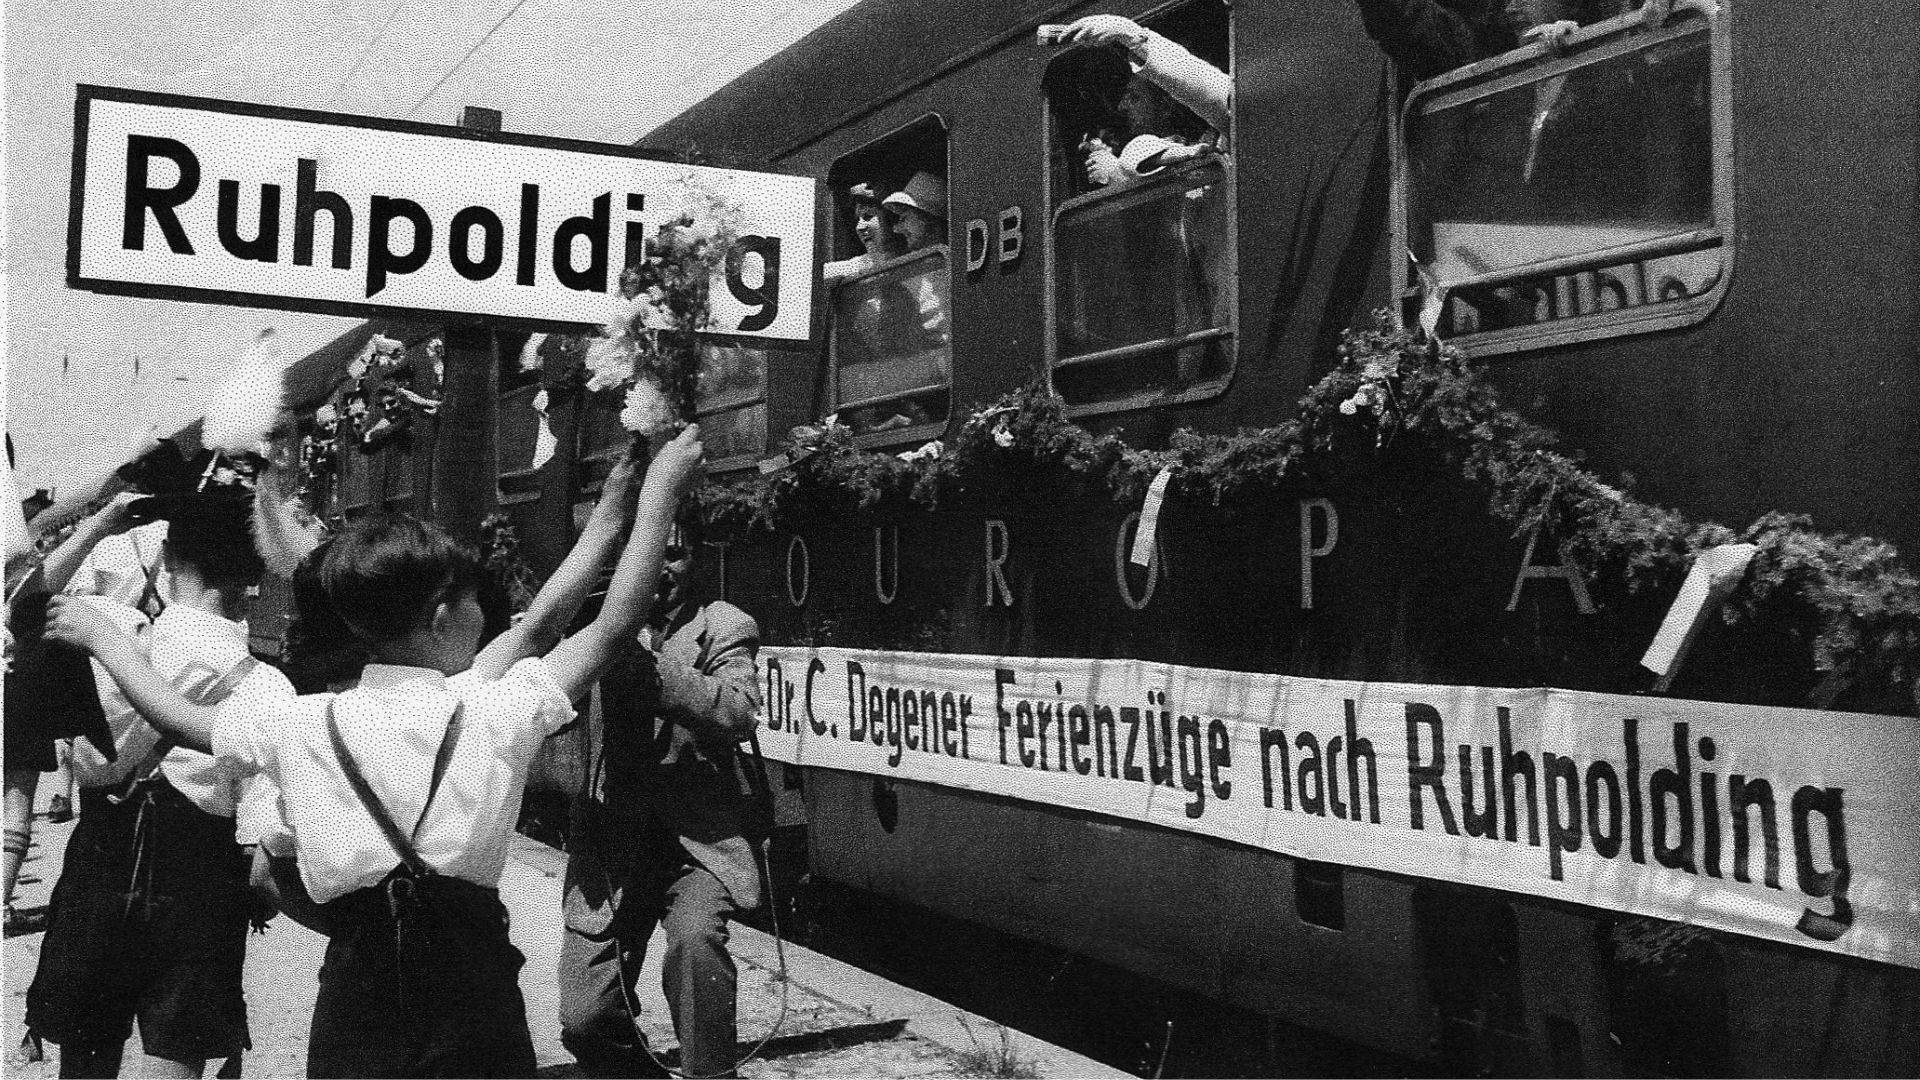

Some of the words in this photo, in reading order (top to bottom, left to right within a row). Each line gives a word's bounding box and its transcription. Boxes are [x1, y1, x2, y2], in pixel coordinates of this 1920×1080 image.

[122, 133, 782, 332] Ruhpoldig
[966, 205, 1023, 272] DB
[766, 657, 800, 731] Dr.
[805, 657, 839, 738] C.
[847, 660, 973, 767] Degener
[994, 668, 1231, 818] Ferienzüge
[1259, 698, 1380, 824] nach
[1404, 700, 1853, 941] Ruhpolding
